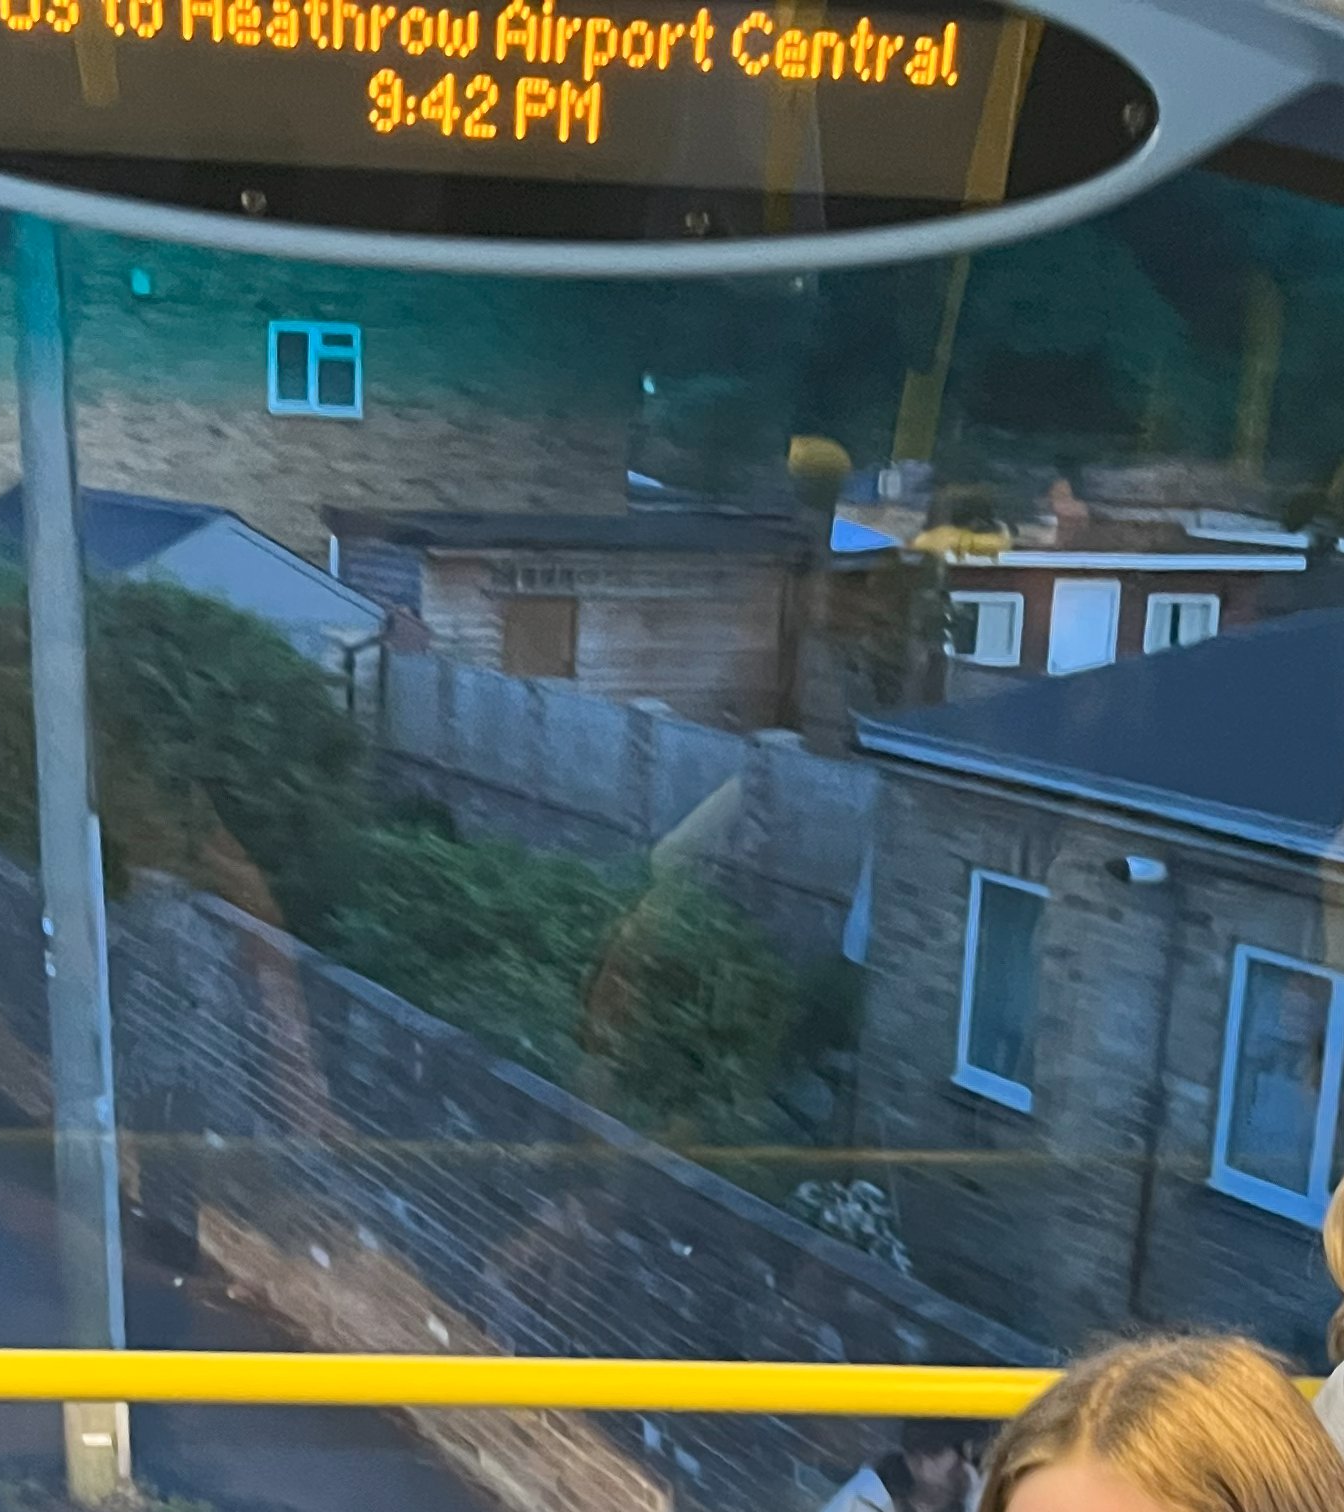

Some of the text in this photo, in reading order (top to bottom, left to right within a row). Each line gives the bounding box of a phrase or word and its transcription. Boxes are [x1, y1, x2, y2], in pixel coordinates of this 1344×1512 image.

[181, 0, 479, 58] Heathrow
[496, 0, 715, 82] Airport
[731, 11, 958, 86] Central
[368, 68, 601, 144] 9:42 PM
